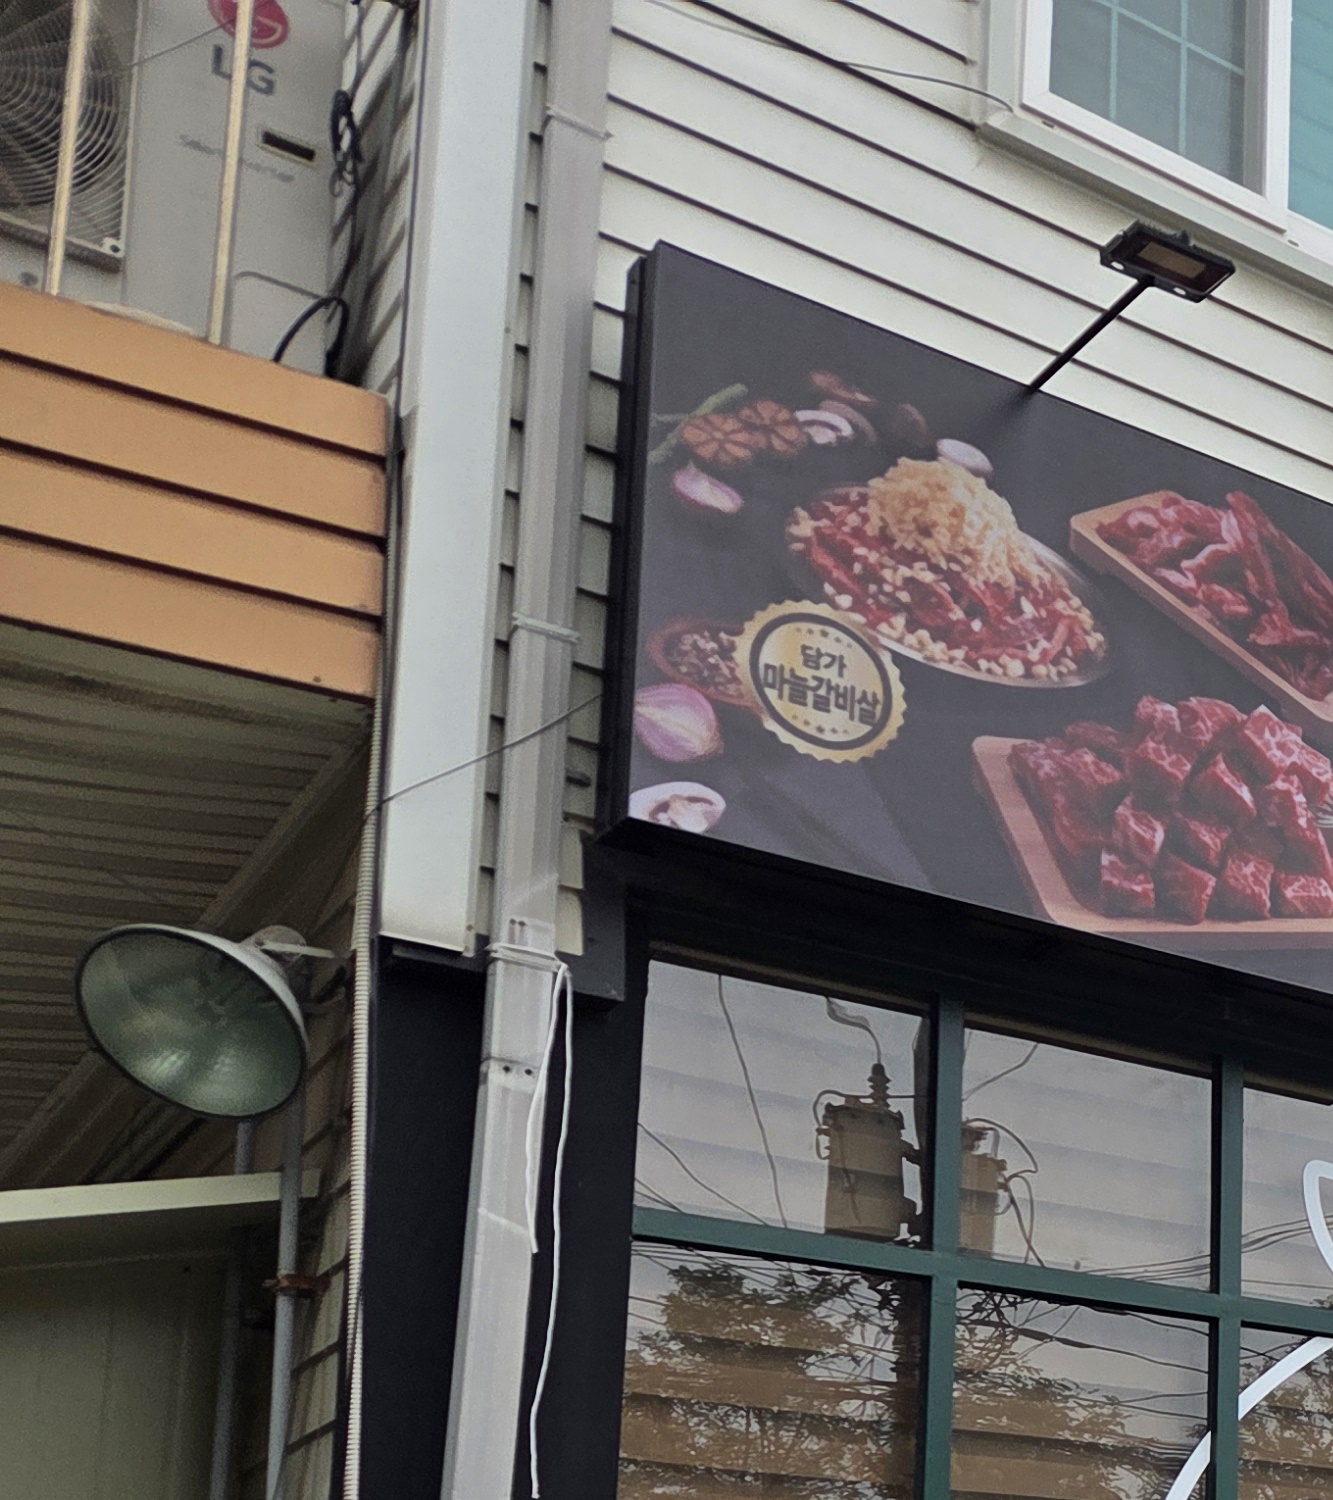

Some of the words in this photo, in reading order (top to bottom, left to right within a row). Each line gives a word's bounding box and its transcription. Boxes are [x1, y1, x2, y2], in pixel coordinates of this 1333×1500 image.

[211, 43, 275, 96] LG
[801, 644, 847, 678] 담가
[763, 662, 880, 727] 마늘갈비살
